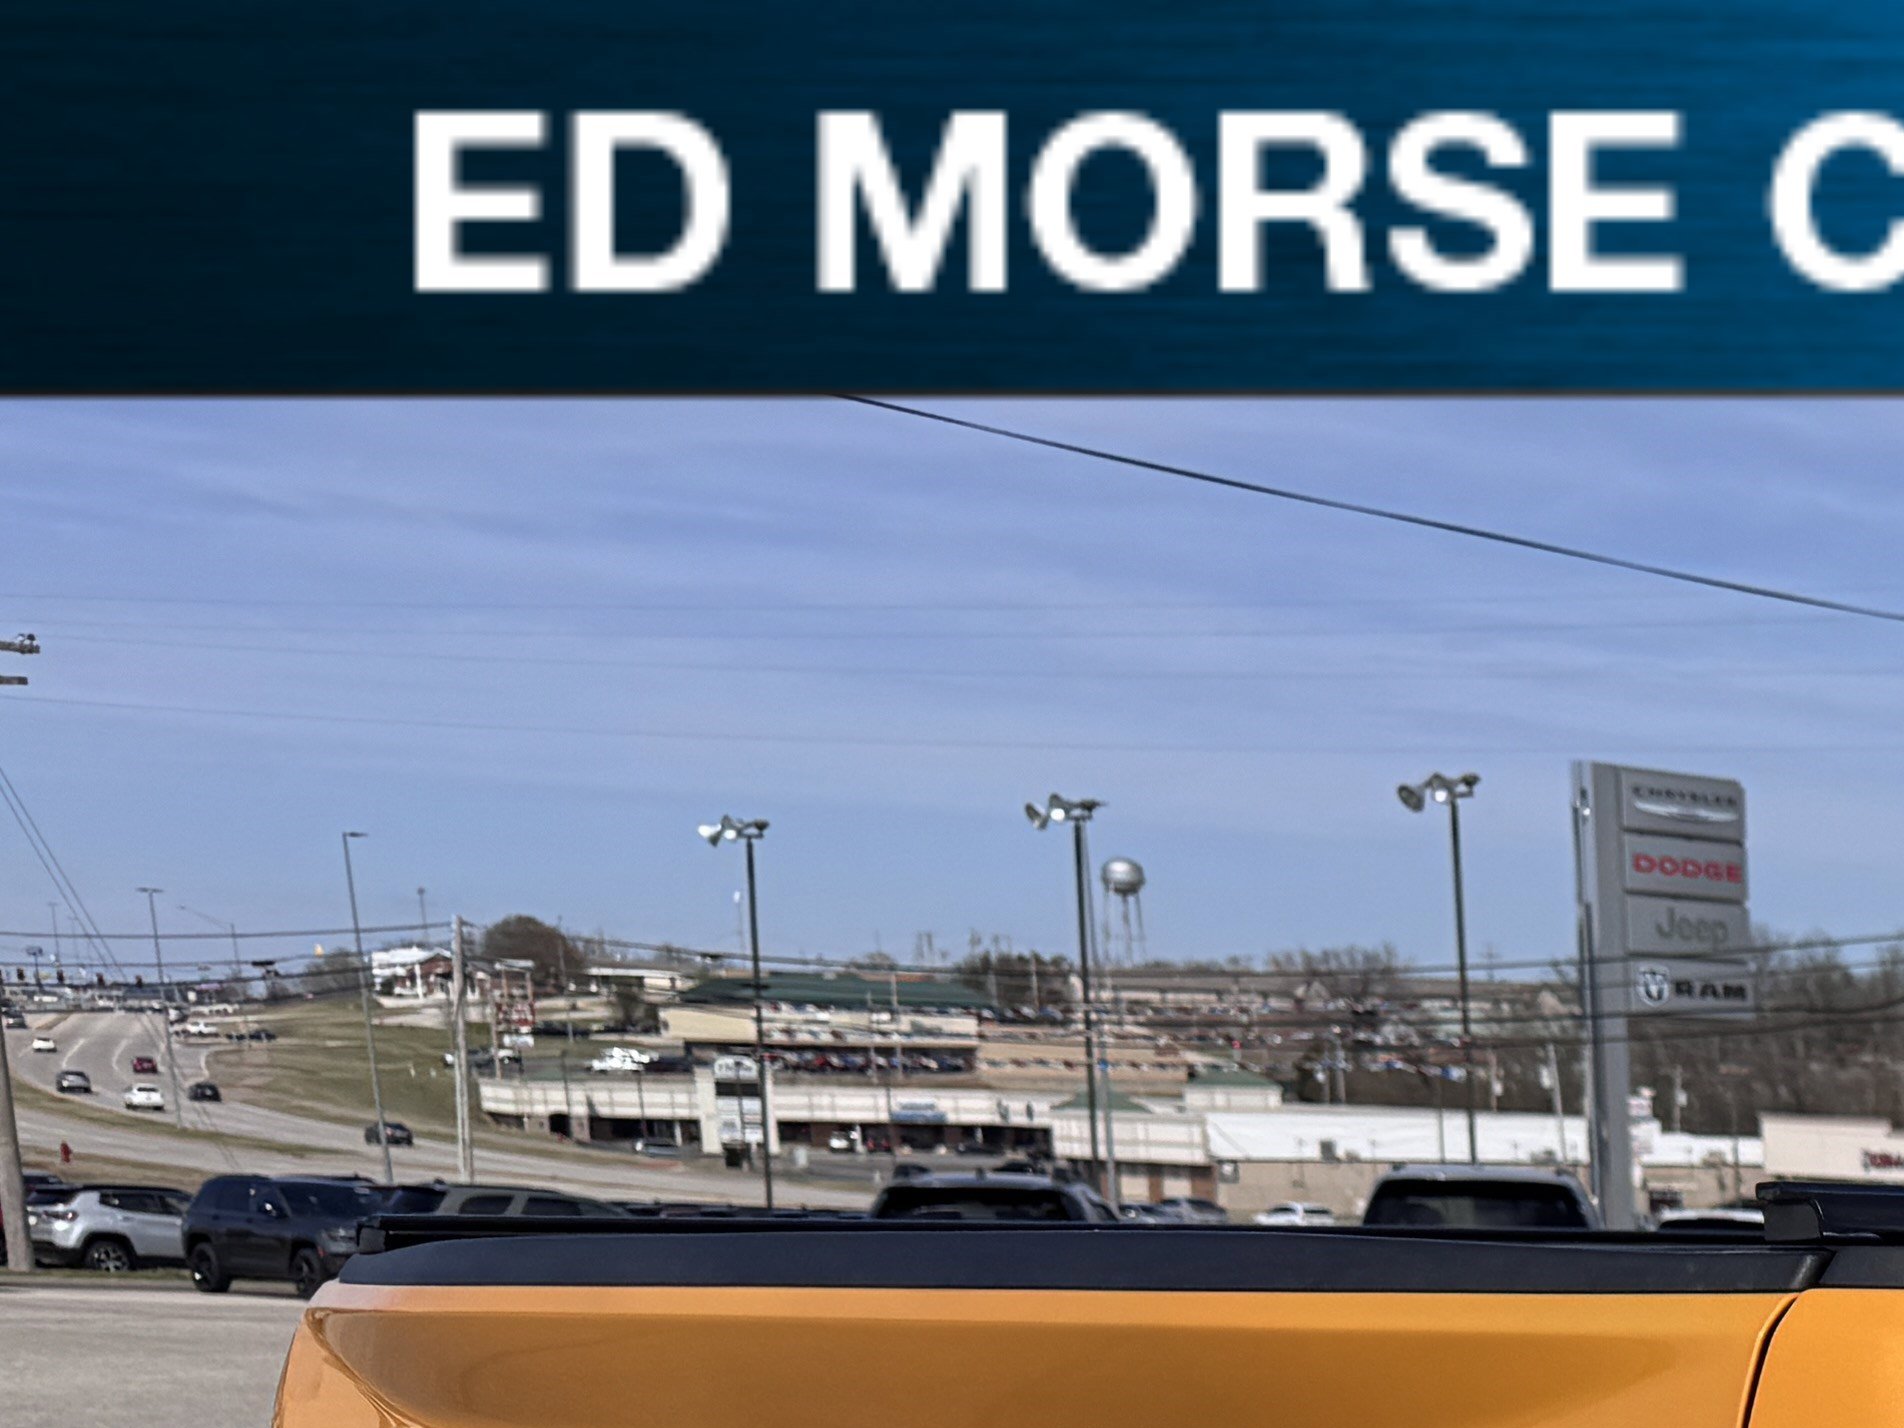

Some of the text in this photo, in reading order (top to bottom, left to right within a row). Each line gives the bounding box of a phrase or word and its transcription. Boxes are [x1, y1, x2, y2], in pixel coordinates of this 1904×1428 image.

[1632, 853, 1742, 883] DODGE
[1655, 906, 1729, 948] Jeep
[1675, 980, 1747, 999] RAM
